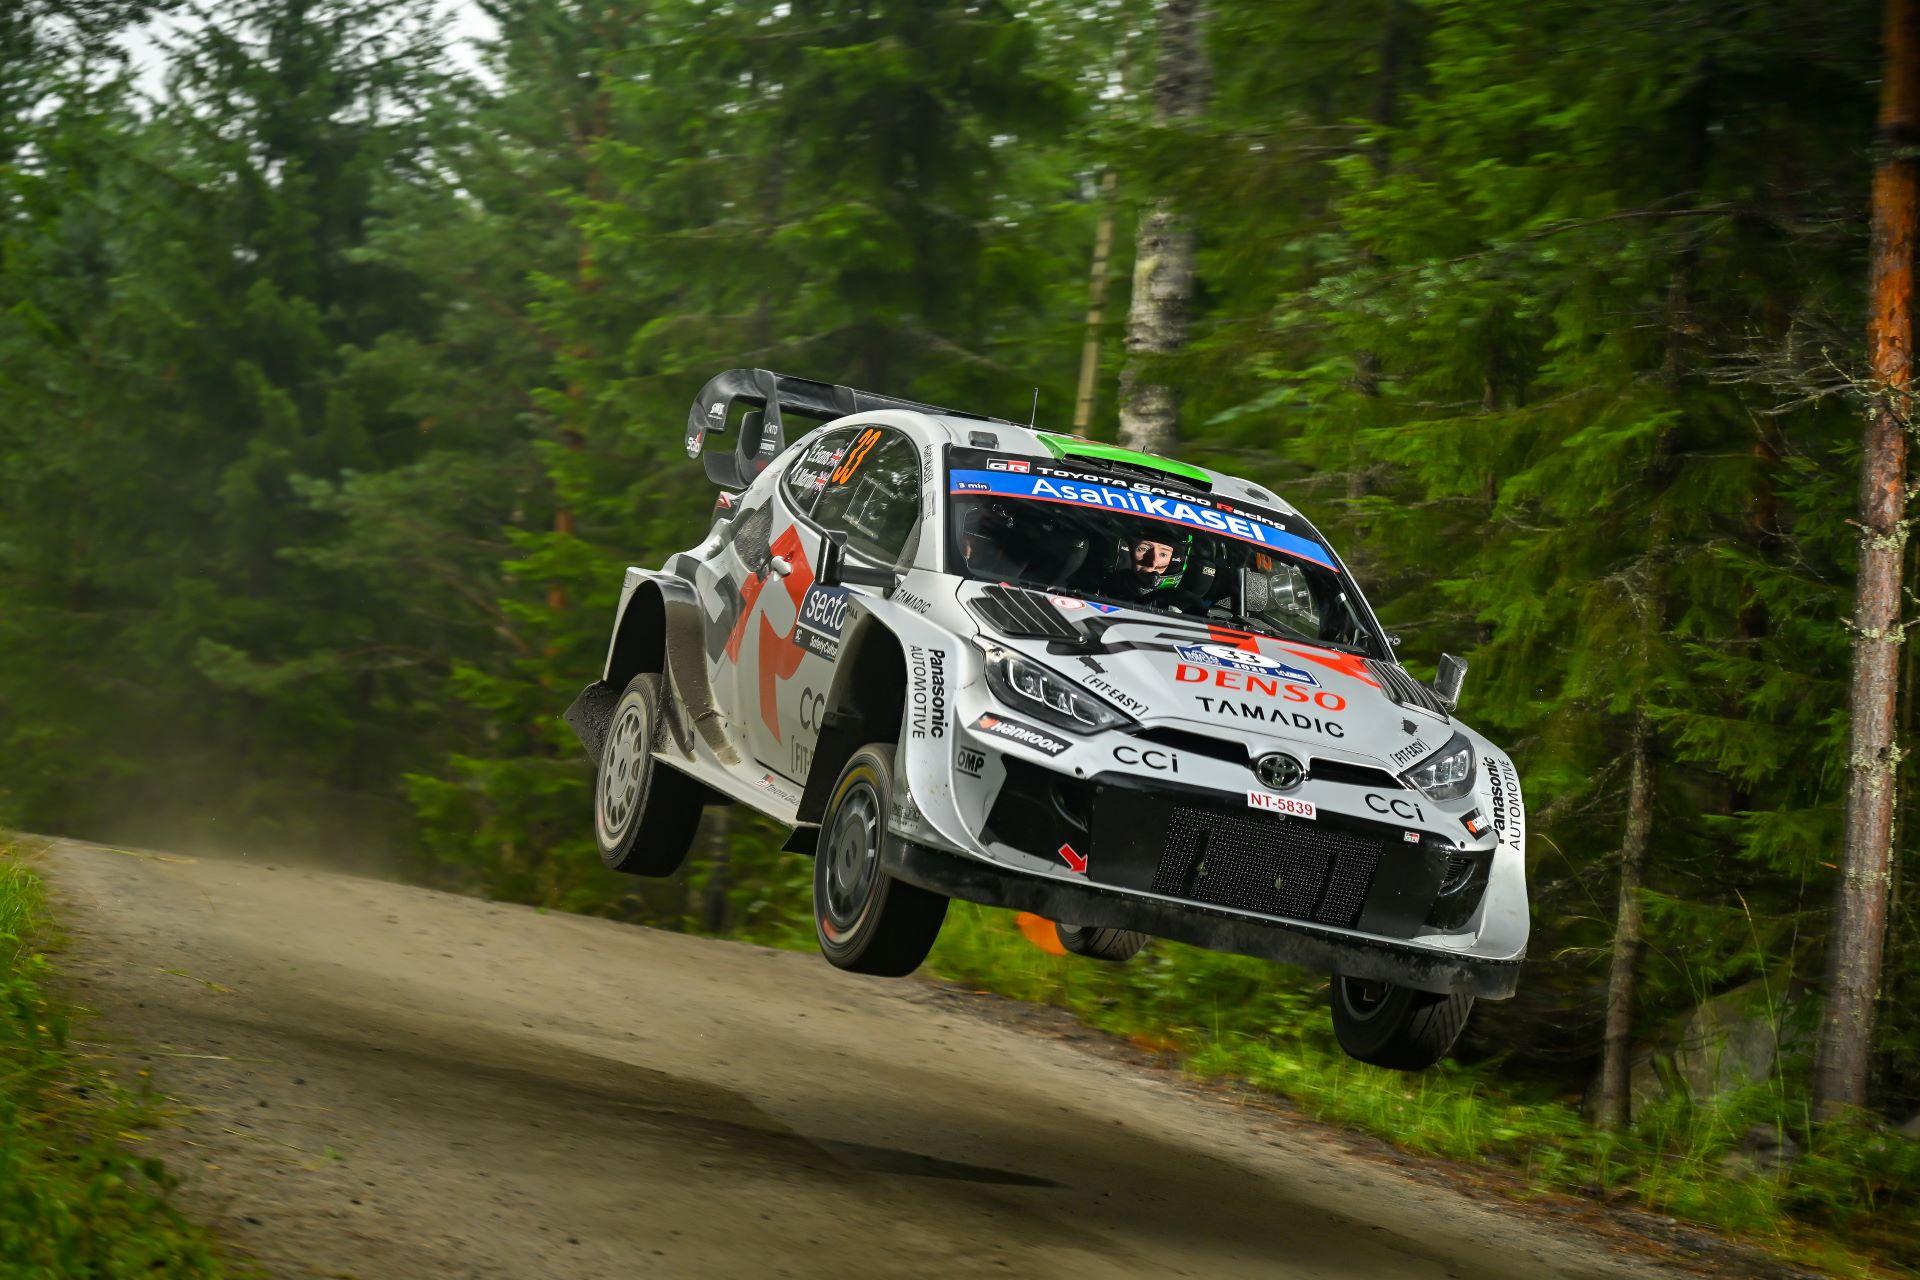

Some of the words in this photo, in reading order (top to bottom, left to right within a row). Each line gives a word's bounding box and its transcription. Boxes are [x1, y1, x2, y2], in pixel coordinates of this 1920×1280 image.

[832, 428, 882, 485] 33
[989, 462, 1029, 473] GR
[968, 482, 988, 490] min
[1036, 467, 1127, 488] TOYOTA
[1129, 482, 1212, 507] GAZOO
[1216, 502, 1286, 531] Racing
[1031, 478, 1266, 542] AsahiKASEI
[806, 590, 849, 631] secto
[896, 588, 932, 615] TAMADIC
[910, 645, 927, 740] AUTOMOTIVE
[928, 648, 948, 739] Panasonic
[1175, 664, 1348, 712] DENSO
[1195, 696, 1345, 738] TAMADIC
[957, 751, 985, 774] OMP
[1250, 792, 1313, 816] NT-5839
[1497, 758, 1521, 851] AUTOMOTIVE
